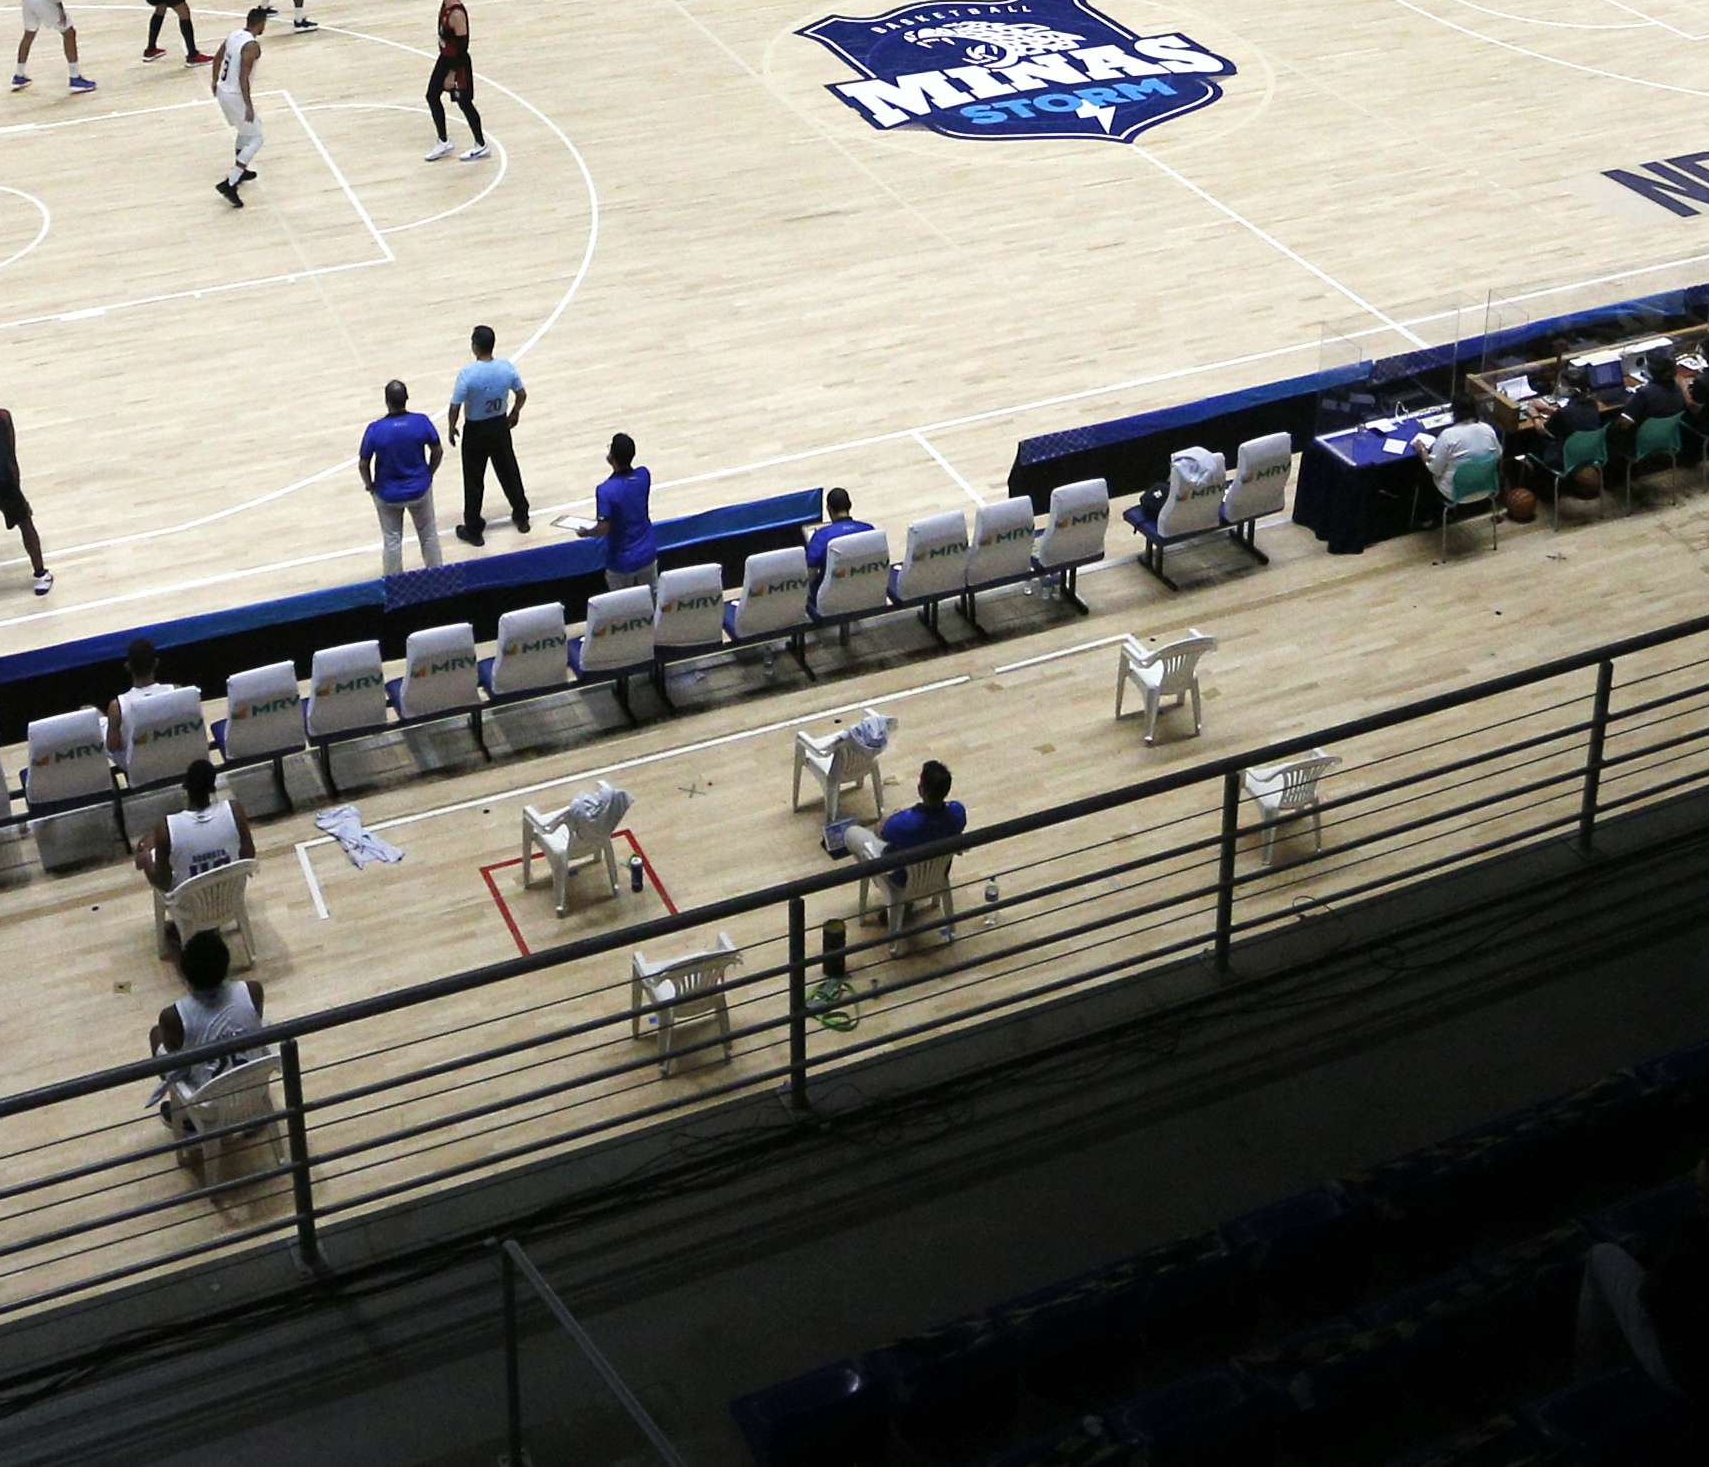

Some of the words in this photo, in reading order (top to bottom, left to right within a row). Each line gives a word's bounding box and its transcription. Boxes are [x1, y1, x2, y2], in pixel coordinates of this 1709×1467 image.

[871, 4, 1032, 34] BASKETBALL
[836, 34, 1225, 128] MINAS
[960, 77, 1178, 125] STORM
[485, 398, 503, 413] 20
[1256, 461, 1291, 481] MRV
[1191, 482, 1226, 501] MRV
[1071, 506, 1110, 525] MRV
[996, 525, 1035, 543] MRV
[929, 542, 969, 558] MRV
[850, 559, 890, 576] MRV
[768, 577, 810, 596] MRV
[677, 594, 722, 612] MRV
[610, 614, 655, 634] MRV
[521, 633, 567, 654] MRV
[430, 655, 477, 677] MRV
[336, 672, 383, 694] MRV
[252, 694, 301, 717] MRV
[152, 718, 204, 740] MRV
[54, 742, 104, 763] MRV
